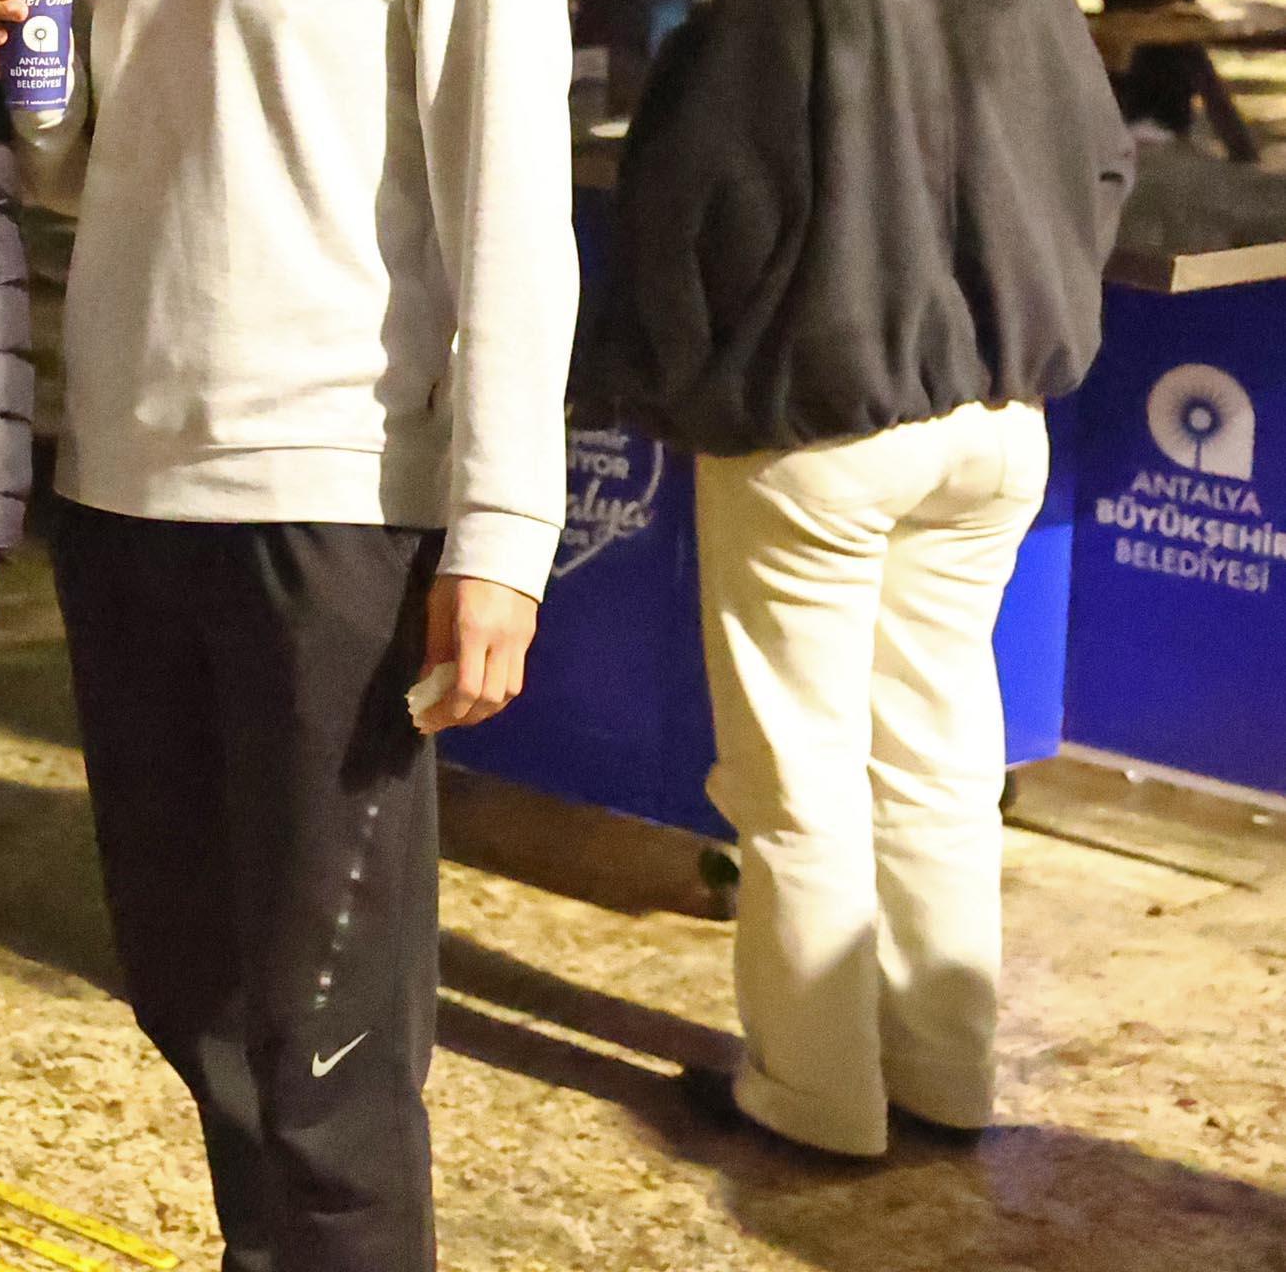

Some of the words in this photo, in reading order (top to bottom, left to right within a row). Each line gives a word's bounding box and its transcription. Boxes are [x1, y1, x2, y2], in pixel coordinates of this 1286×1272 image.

[18, 57, 60, 66] ANTALYA
[1131, 471, 1262, 516] ANTALYA
[1115, 537, 1270, 594] BELEDİYESİ
